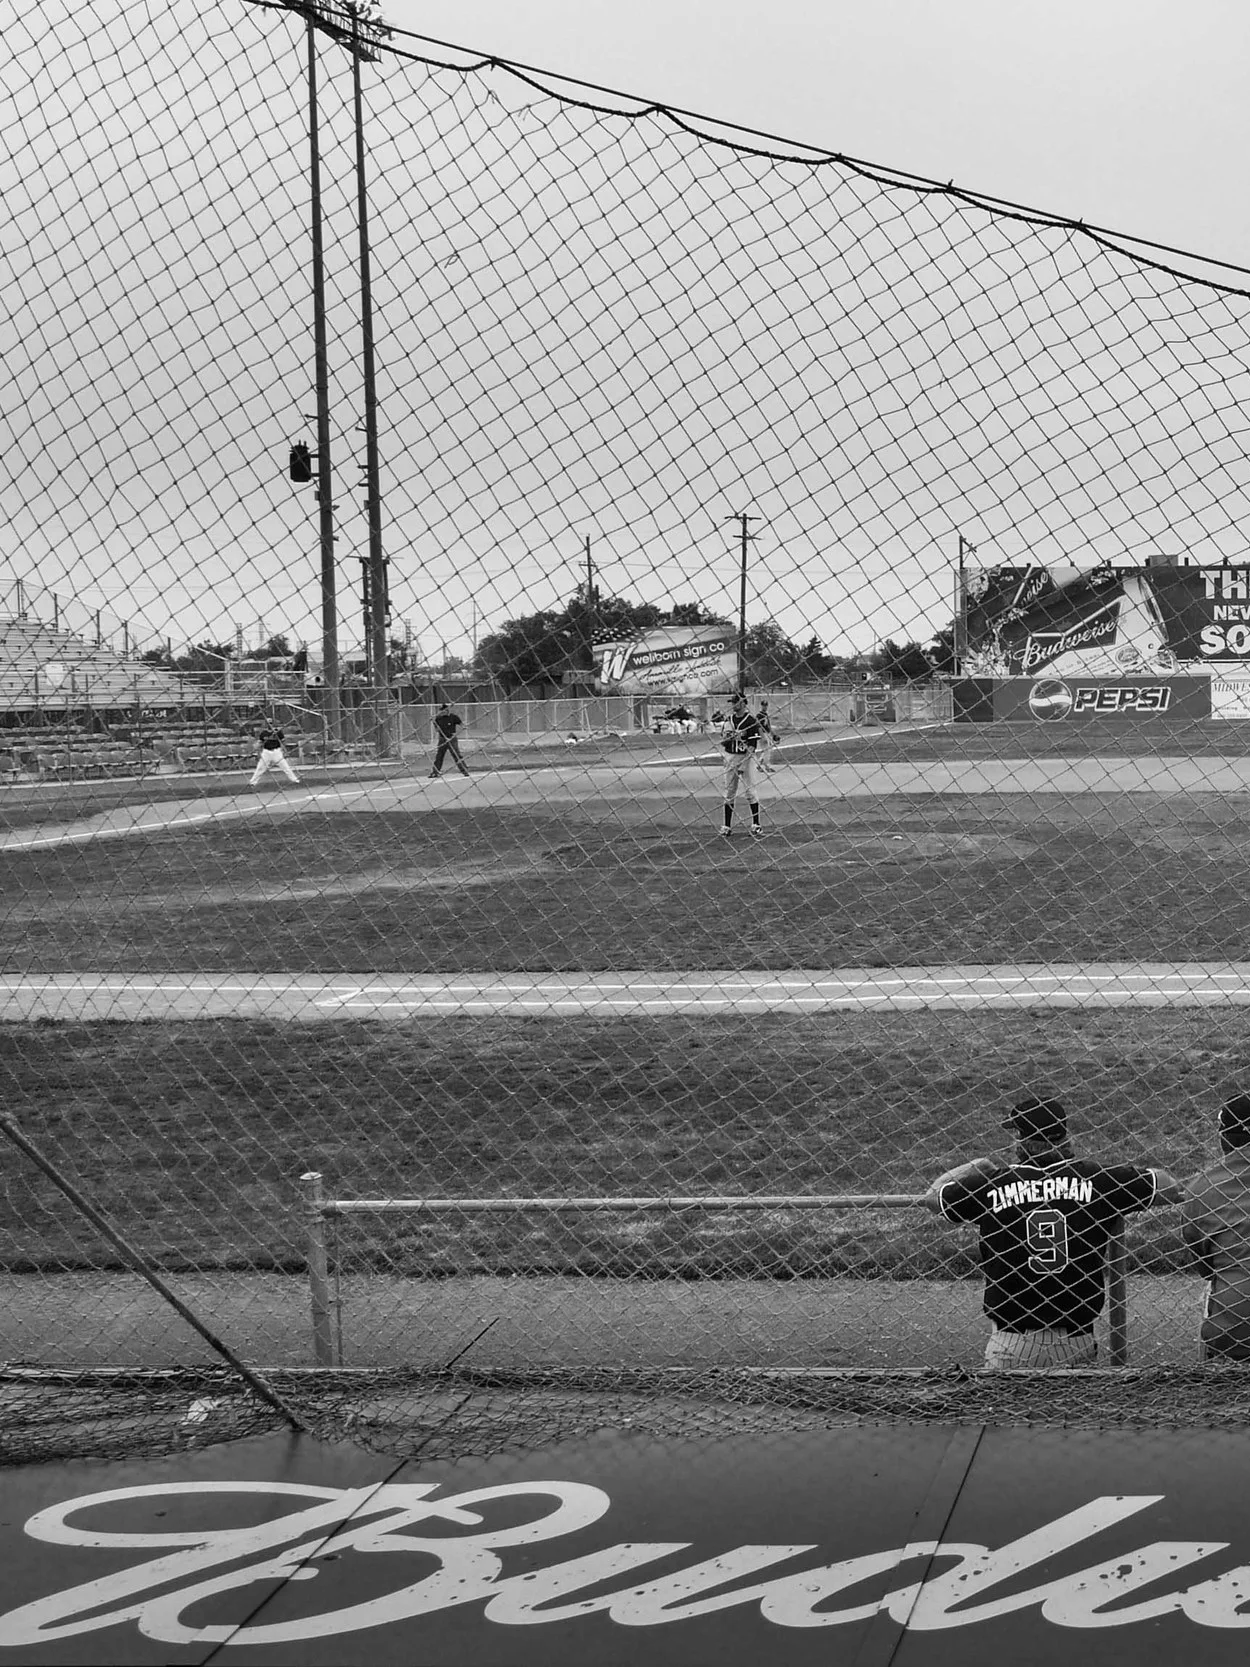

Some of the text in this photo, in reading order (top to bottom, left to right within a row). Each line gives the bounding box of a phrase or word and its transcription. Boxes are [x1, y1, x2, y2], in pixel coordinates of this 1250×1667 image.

[683, 645, 707, 658] sign
[709, 642, 725, 653] co
[1073, 686, 1172, 712] PEPSI
[986, 1176, 1094, 1214] ZIMMERMAN
[1025, 1208, 1069, 1275] 9
